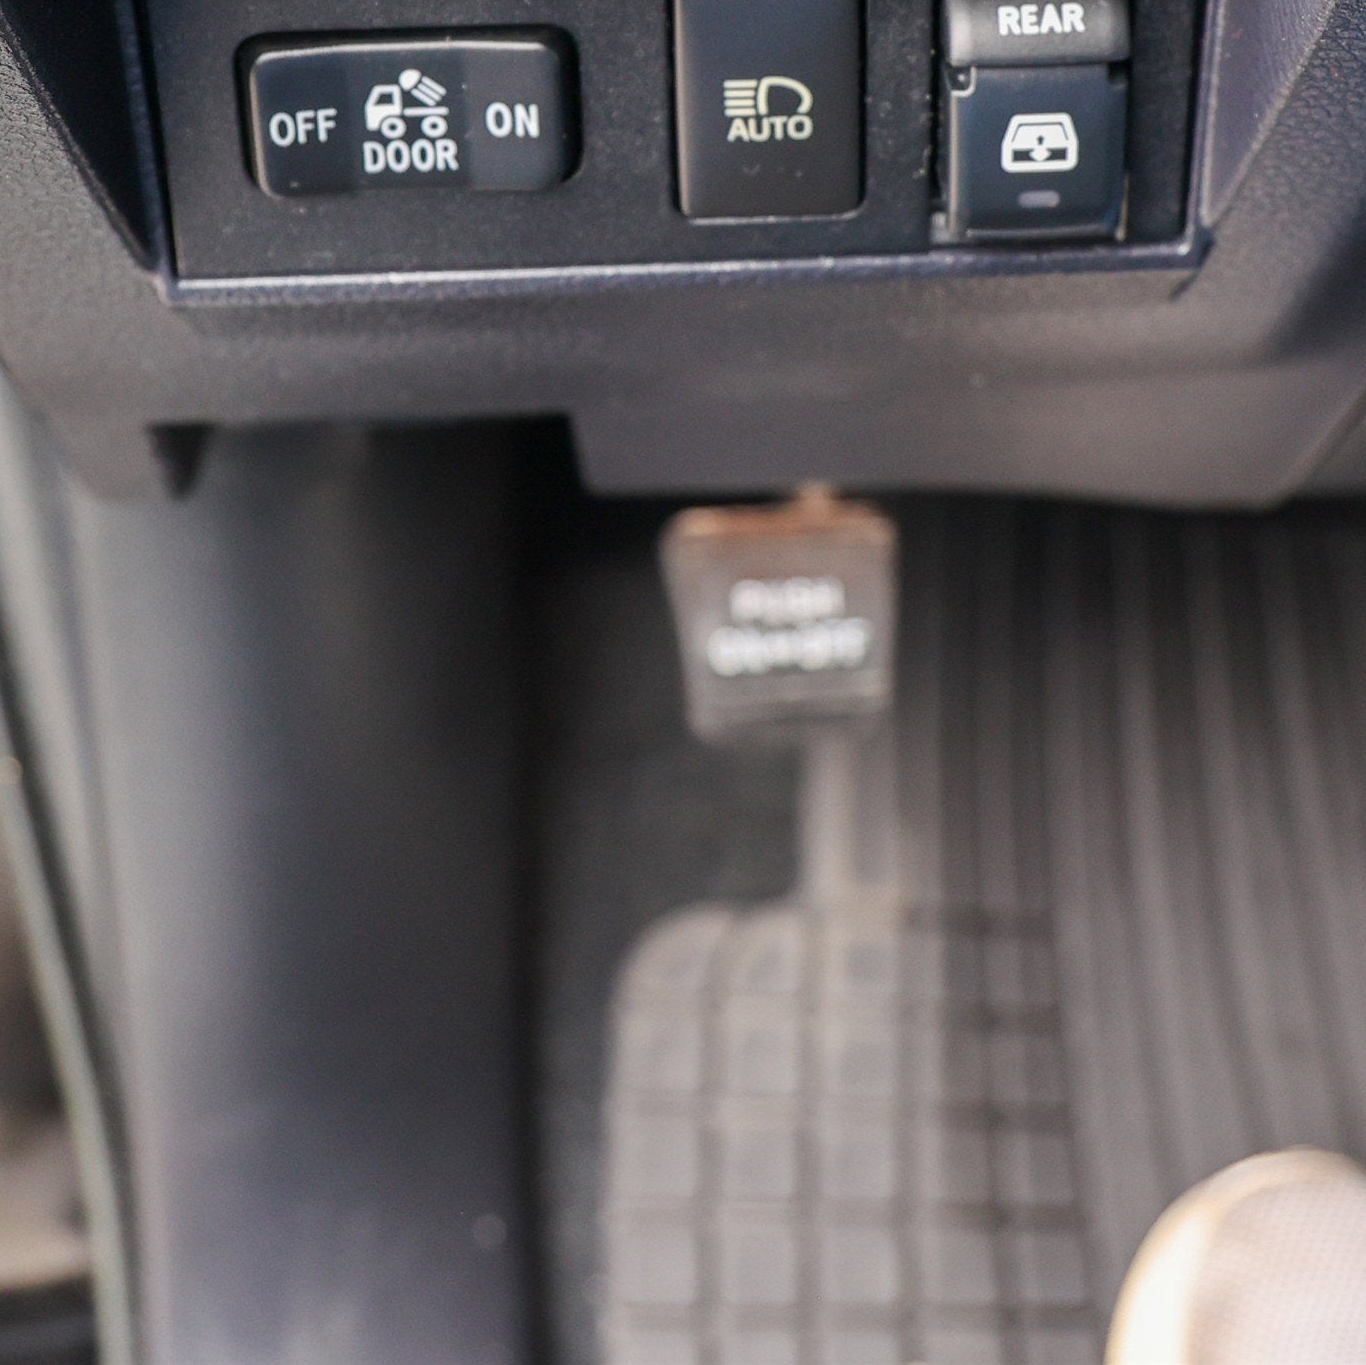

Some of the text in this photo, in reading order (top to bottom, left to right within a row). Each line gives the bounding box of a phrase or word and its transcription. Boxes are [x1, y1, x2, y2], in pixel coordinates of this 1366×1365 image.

[997, 1, 1086, 35] REAR
[269, 108, 338, 147] OFF
[485, 102, 540, 138] ON
[727, 115, 814, 142] AUTO
[363, 139, 459, 174] DOOR
